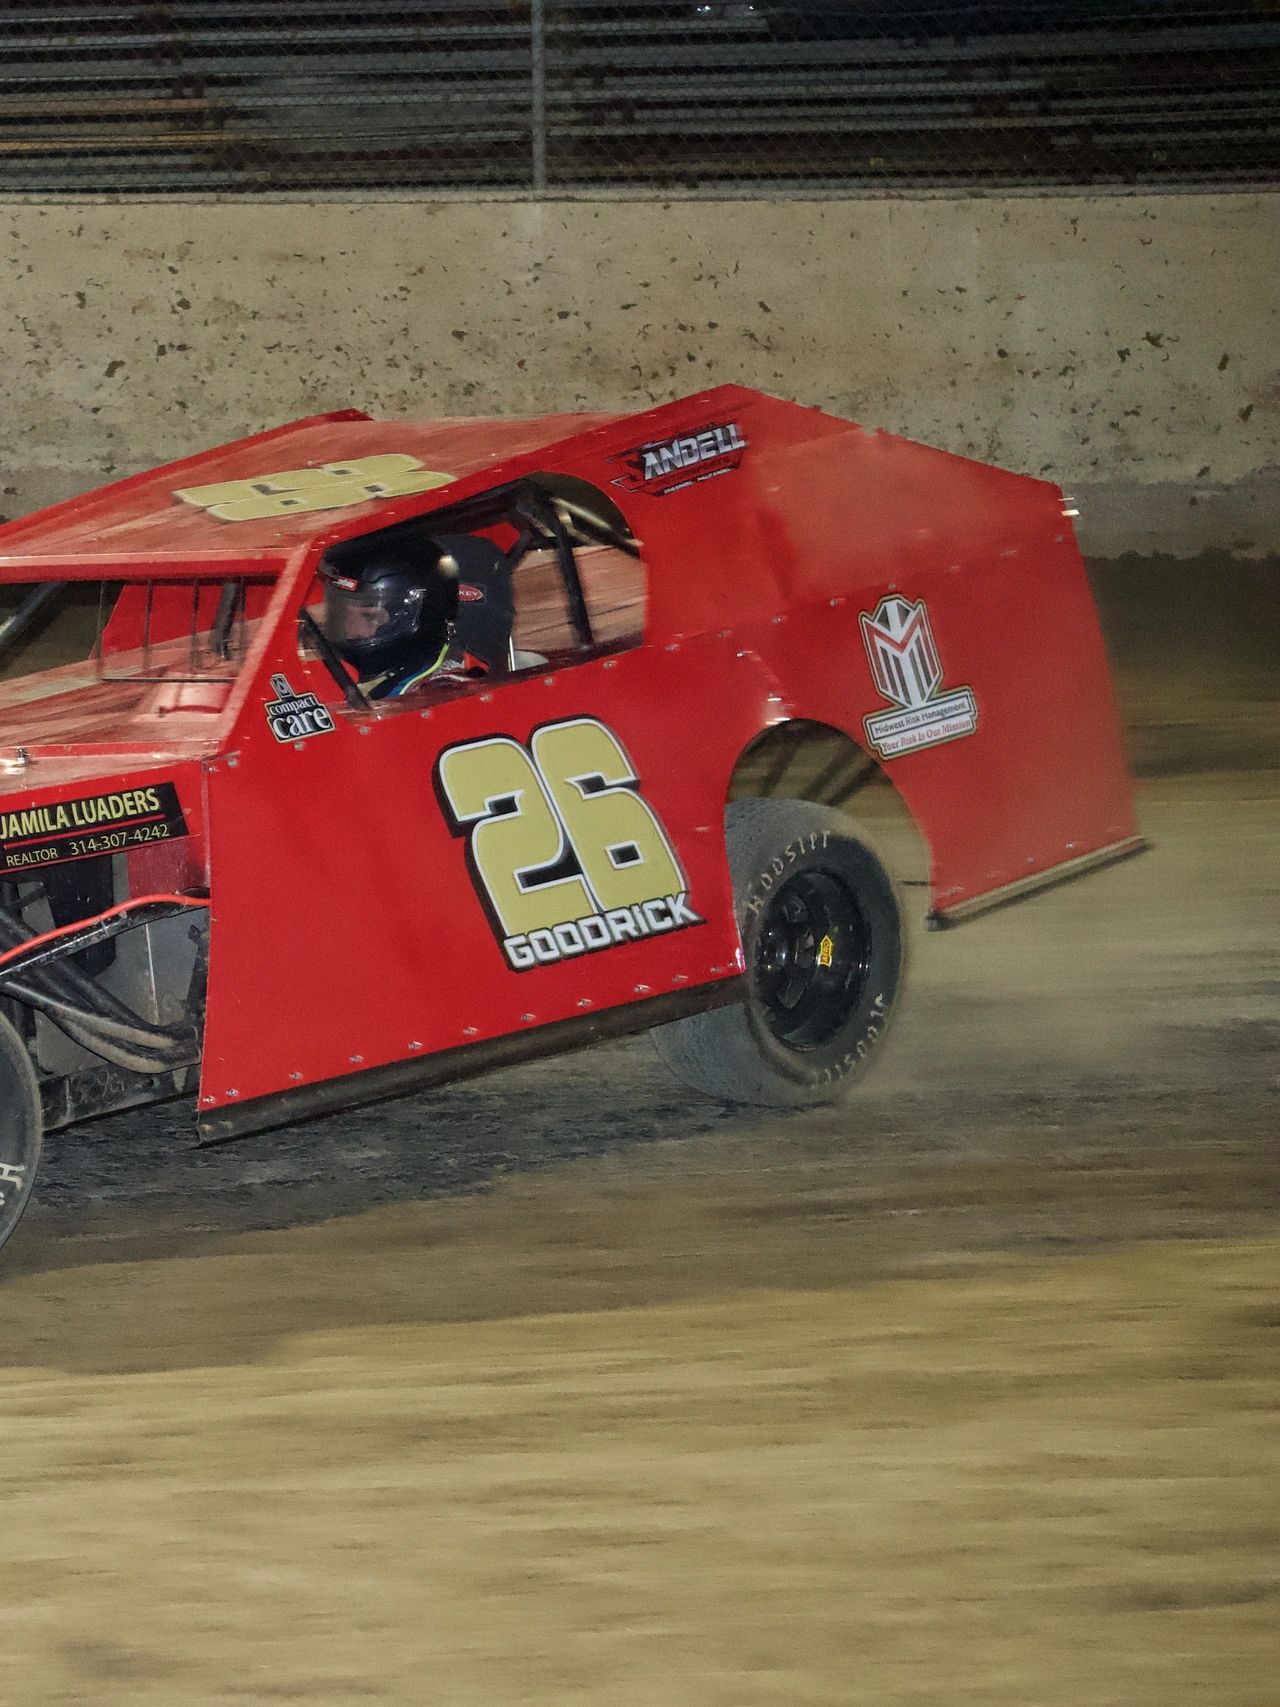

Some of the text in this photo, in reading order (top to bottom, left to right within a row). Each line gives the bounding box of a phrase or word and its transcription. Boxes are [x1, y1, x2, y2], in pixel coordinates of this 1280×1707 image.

[458, 589, 479, 597] KEY
[269, 696, 316, 716] compact
[874, 702, 967, 735] Midwest Risk Management
[272, 707, 331, 739] care
[881, 741, 899, 752] Your
[900, 735, 918, 747] Risk
[926, 728, 941, 739] Our
[942, 720, 971, 734] Mission
[0, 787, 160, 840] JAMILA LUADERS
[434, 715, 690, 940] 26
[6, 823, 171, 867] REALTOR 314-307-4242
[502, 892, 705, 970] GOODRICK
